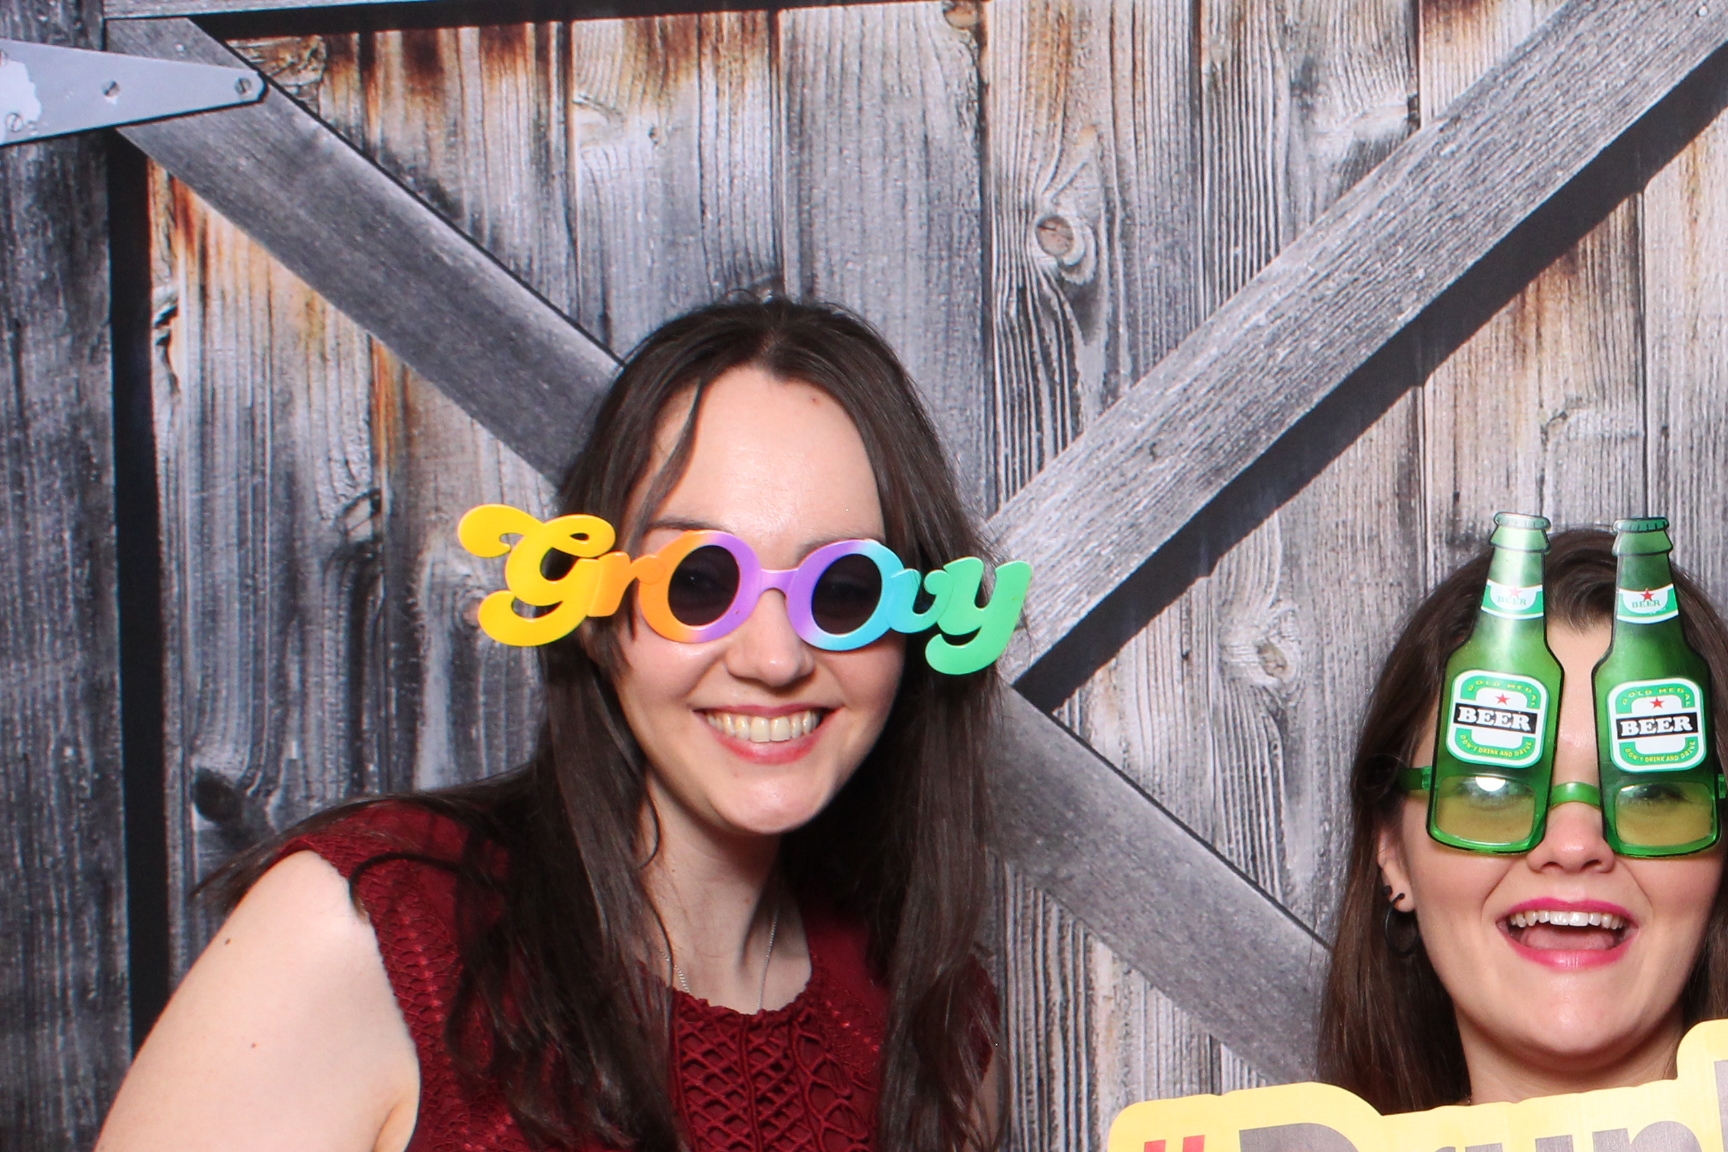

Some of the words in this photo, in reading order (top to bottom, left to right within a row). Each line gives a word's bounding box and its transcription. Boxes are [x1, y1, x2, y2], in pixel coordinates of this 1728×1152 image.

[1497, 595, 1527, 606] BEER
[1631, 599, 1661, 608] BEER
[1467, 679, 1501, 693] GOLD
[1507, 683, 1537, 706] MEDAL
[1622, 689, 1652, 706] GOLD
[1658, 687, 1691, 707] MEDAL
[1457, 706, 1531, 732] BEER
[1620, 715, 1693, 737] BEER
[1460, 734, 1477, 752] DON'T
[1478, 747, 1498, 756] DRINK
[1499, 748, 1513, 758] AND
[1514, 741, 1532, 756] DRIVE
[1625, 747, 1644, 761] DON'T
[1644, 755, 1665, 763] DRINK
[1665, 754, 1679, 763] AND
[1680, 741, 1696, 759] DRIVE
